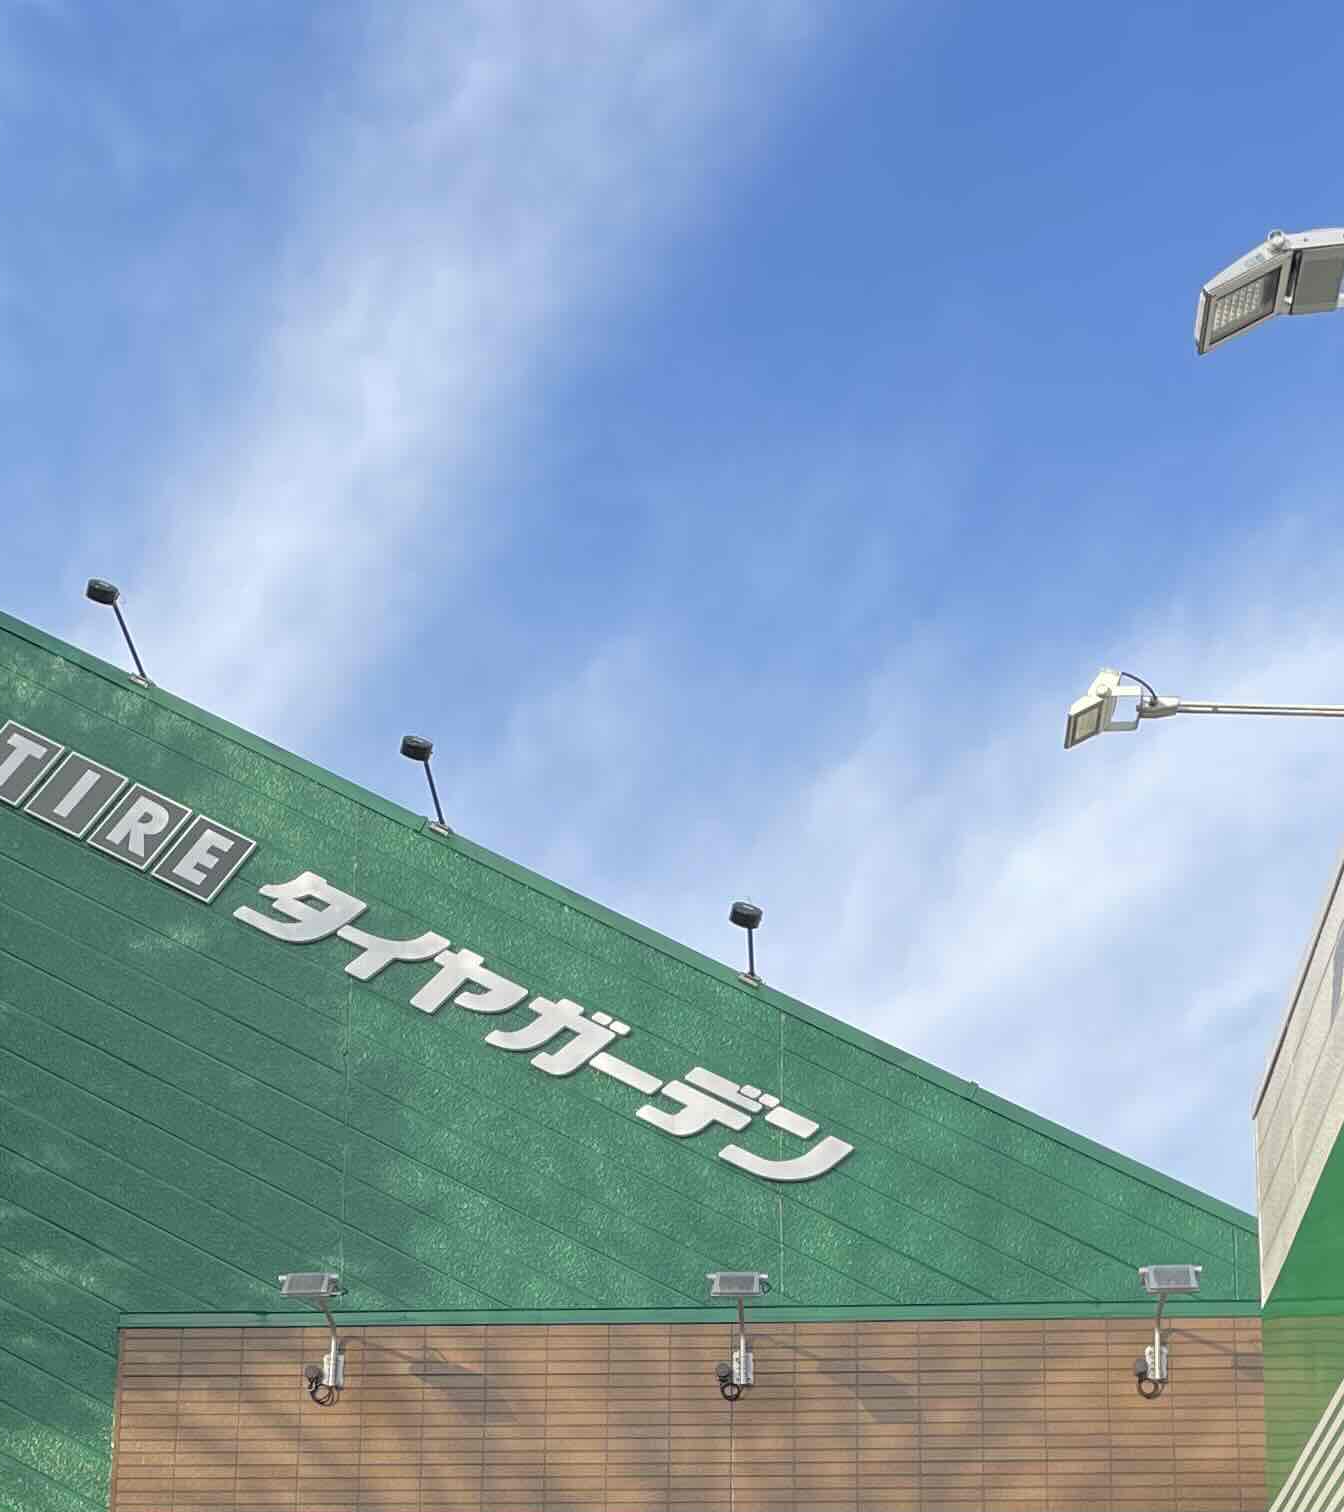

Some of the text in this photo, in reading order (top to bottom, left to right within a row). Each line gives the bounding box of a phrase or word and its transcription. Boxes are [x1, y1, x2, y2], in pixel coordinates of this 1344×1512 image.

[233, 870, 855, 1183] タイヤガーデン
